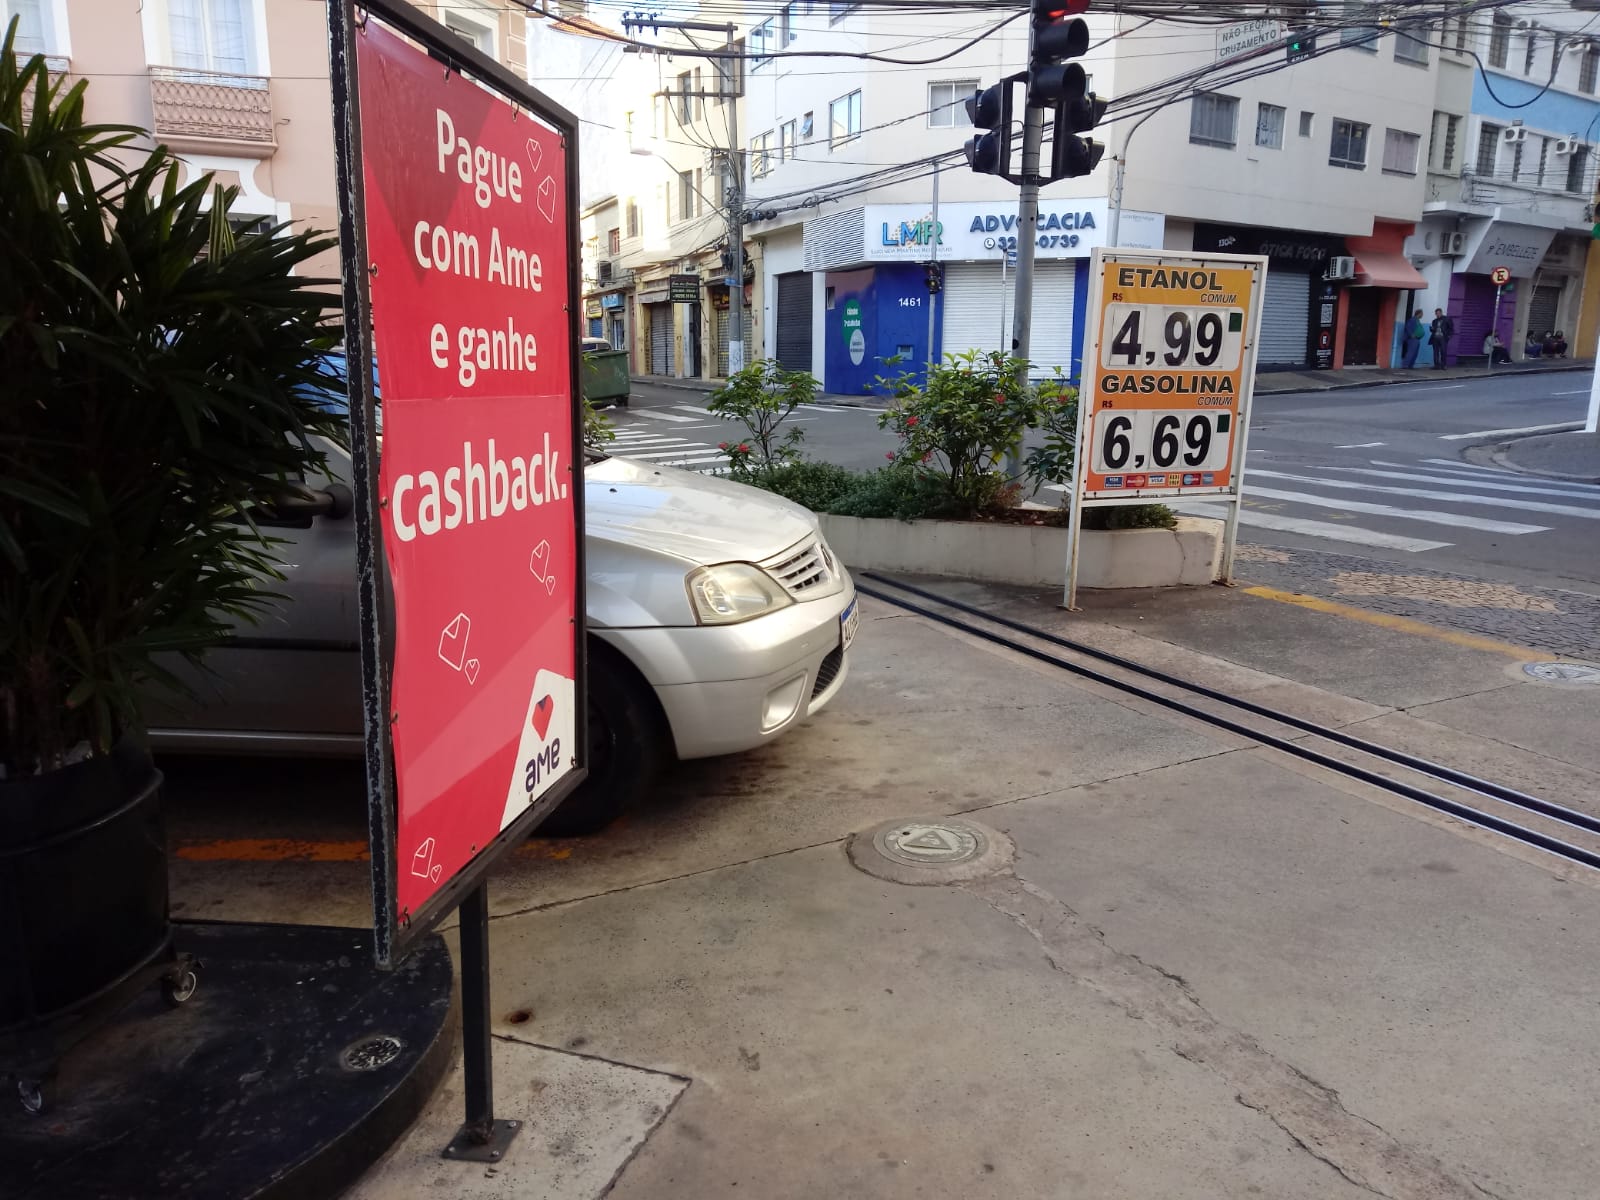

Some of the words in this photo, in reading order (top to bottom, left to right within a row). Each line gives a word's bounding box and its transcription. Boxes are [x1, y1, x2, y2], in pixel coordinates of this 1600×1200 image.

[1220, 29, 1277, 57] CRUZAMENTO
[436, 108, 522, 209] Pague
[882, 221, 943, 246] LMR
[969, 211, 1096, 232] ADVCACIA
[997, 234, 1080, 250] 32-0739
[414, 220, 480, 279] com
[487, 226, 542, 292] Ame
[1118, 267, 1223, 291] ETANOL
[898, 297, 921, 307] 1461
[1112, 292, 1124, 301] R$
[1200, 293, 1237, 303] COMUM
[1112, 310, 1223, 367] 4,99
[430, 323, 449, 369] e
[458, 316, 537, 388] ganhe
[1101, 374, 1234, 394] GASOLINA
[1102, 400, 1113, 409] R$
[1197, 396, 1233, 406] COMUM
[1103, 414, 1212, 469] 6,69
[392, 432, 567, 542] cashback.
